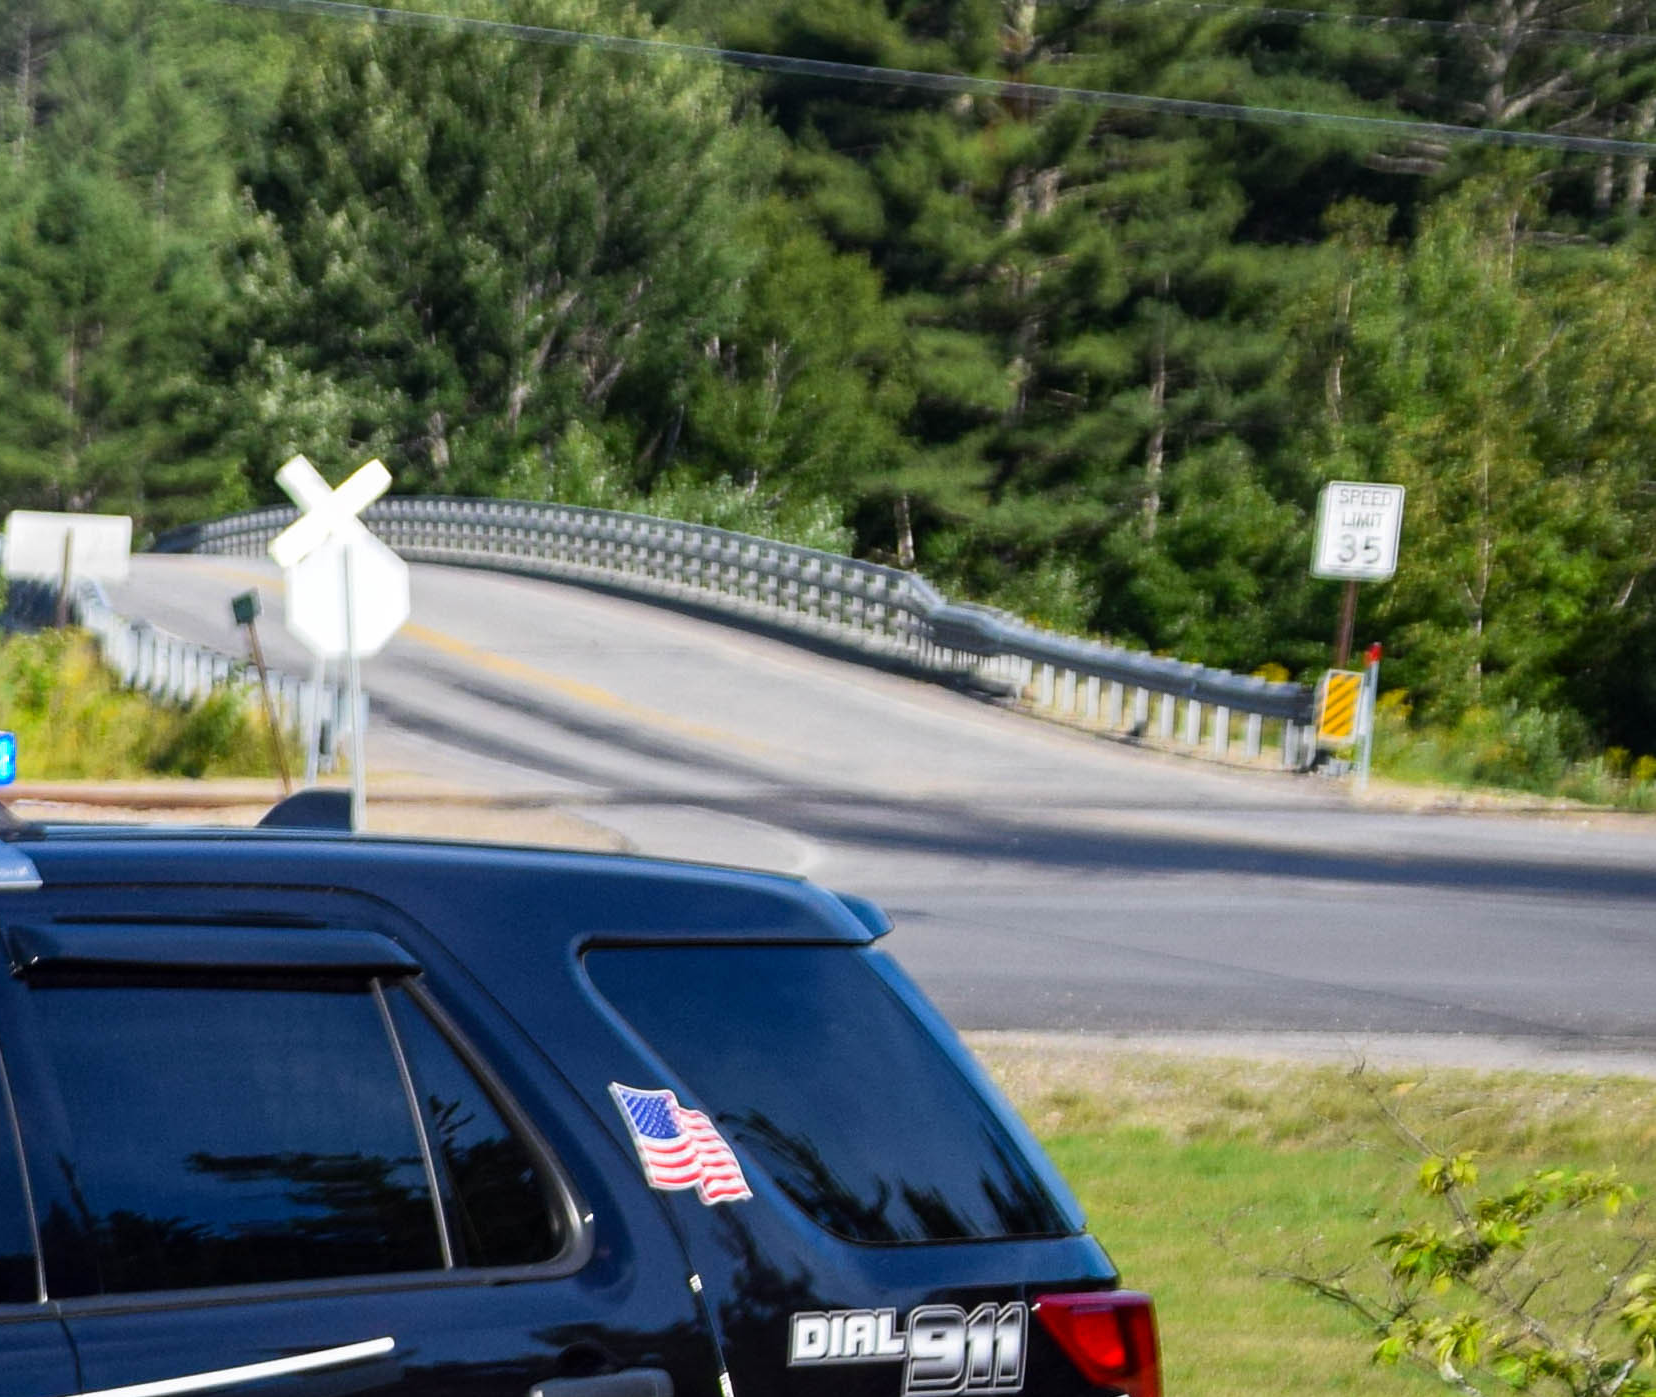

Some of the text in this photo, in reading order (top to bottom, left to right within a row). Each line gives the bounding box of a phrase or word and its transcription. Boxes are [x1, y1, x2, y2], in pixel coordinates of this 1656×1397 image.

[1339, 488, 1392, 507] SPEED
[1341, 511, 1384, 529] LIMIT
[1337, 534, 1382, 565] 35
[788, 1301, 1029, 1397] DIAL 911
